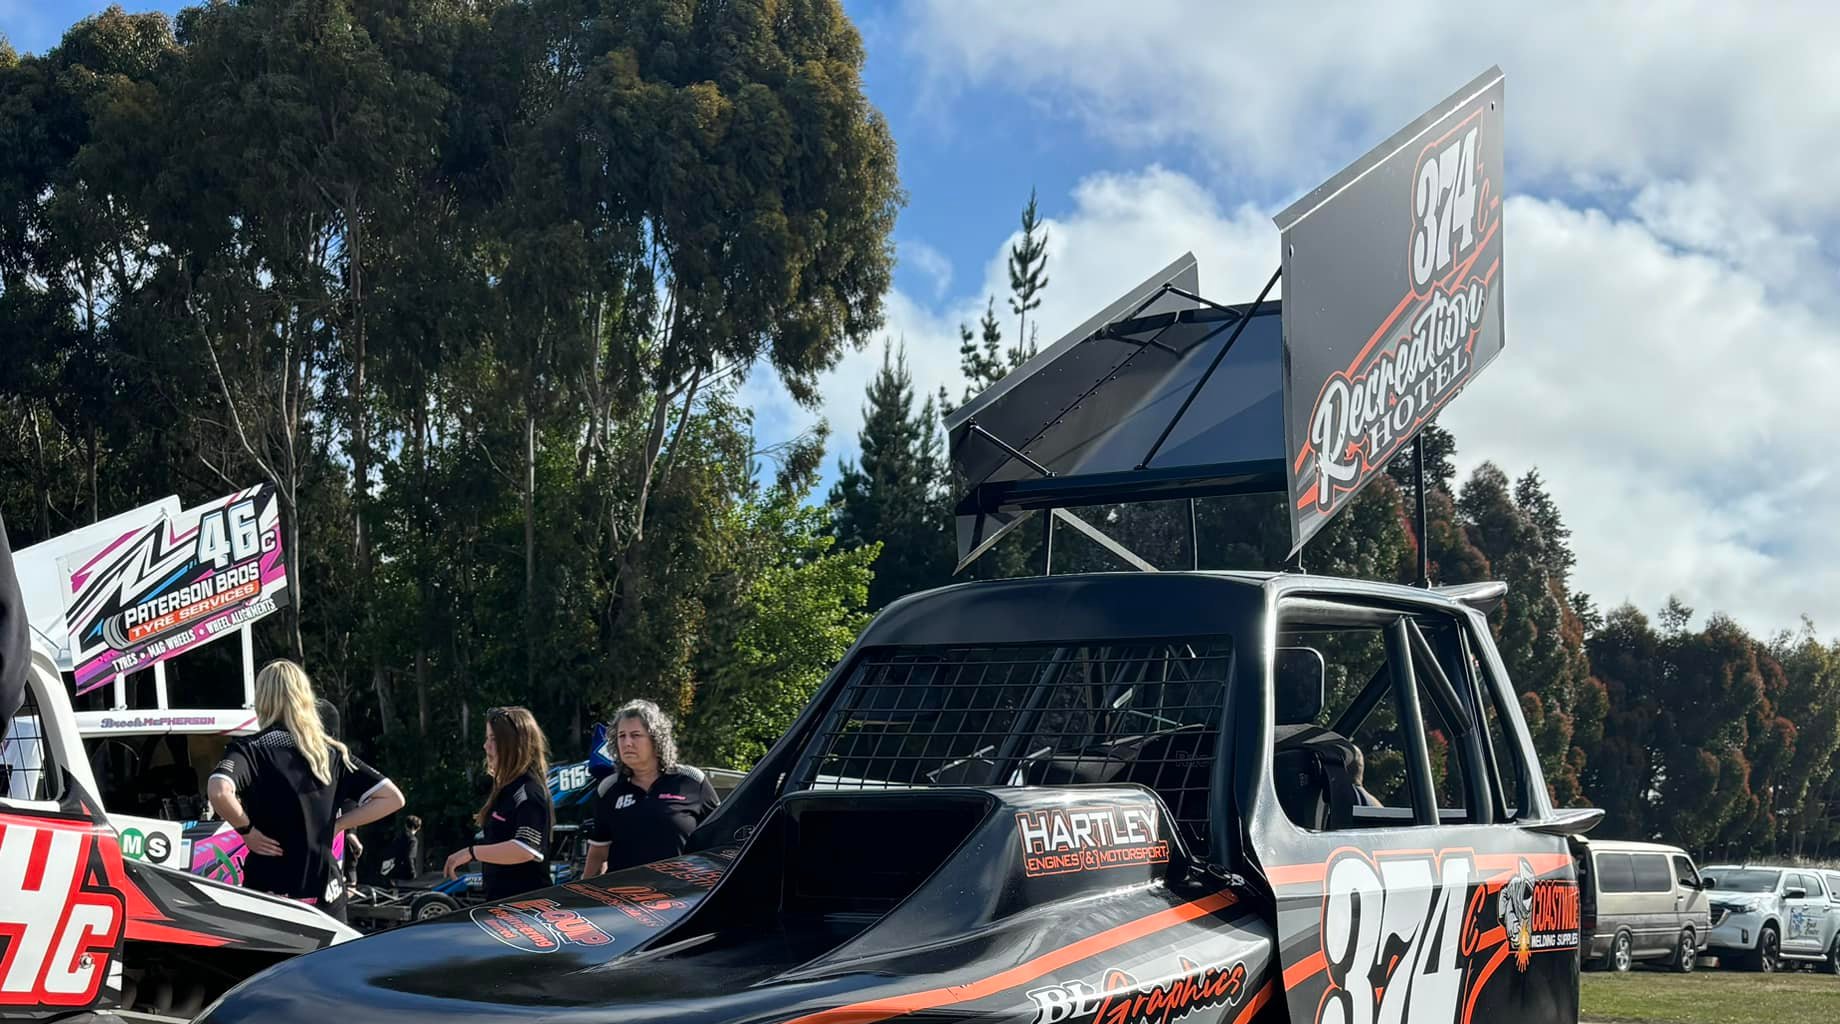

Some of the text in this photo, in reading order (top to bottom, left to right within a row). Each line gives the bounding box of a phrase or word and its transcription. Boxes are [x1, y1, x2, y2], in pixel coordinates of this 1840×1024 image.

[1312, 282, 1485, 505] Recreation
[1368, 346, 1467, 457] HOTEL
[125, 561, 259, 629] PATERSON BROS
[132, 583, 255, 638] TYRE SERVICES
[112, 598, 277, 673] TYRES MAG WHEELS WHEEL ALIGNMENTS
[122, 834, 167, 858] M S
[1019, 808, 1158, 853] HARTLEY
[1027, 845, 1167, 872] ENGINES & MOTORSPORT
[1531, 932, 1578, 948] WELDING SUPPLIES
